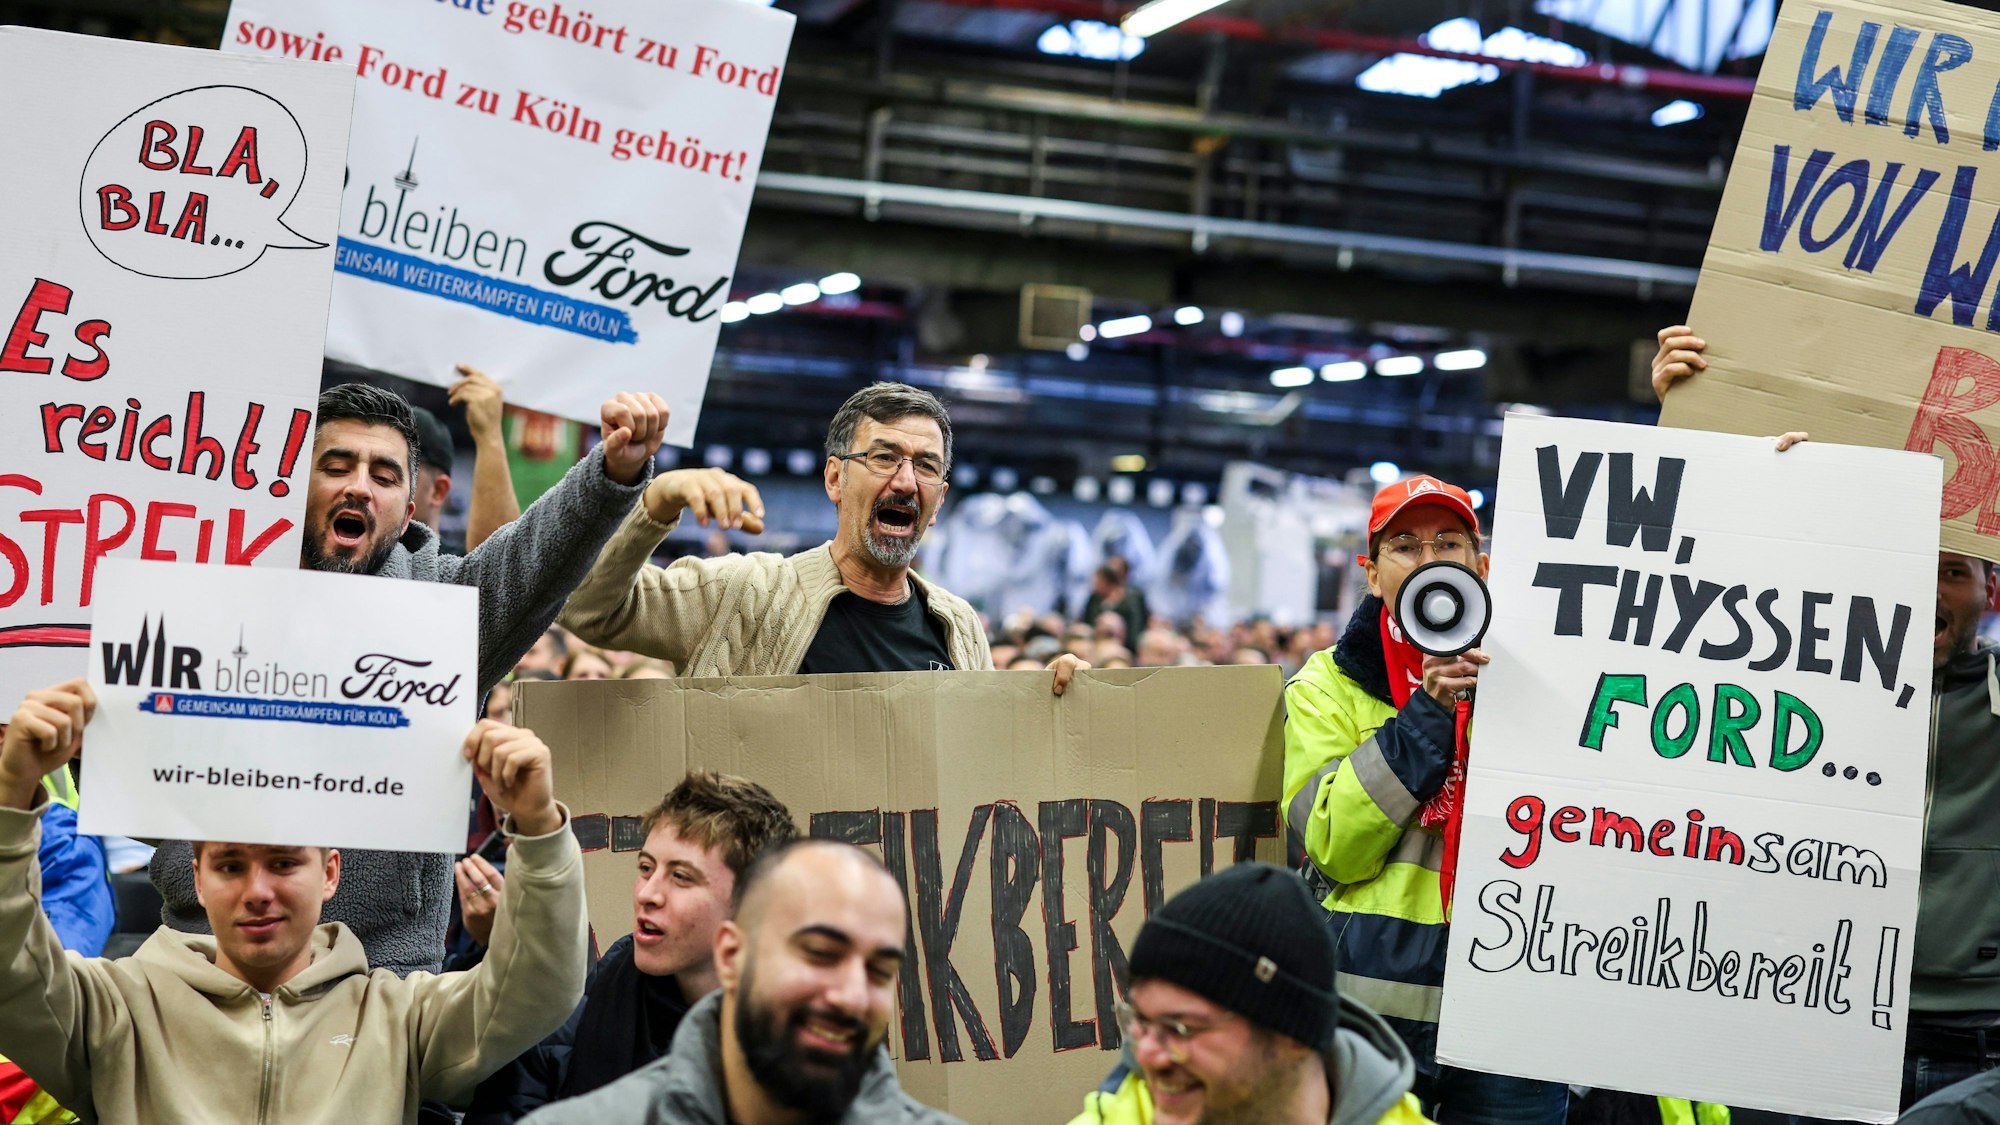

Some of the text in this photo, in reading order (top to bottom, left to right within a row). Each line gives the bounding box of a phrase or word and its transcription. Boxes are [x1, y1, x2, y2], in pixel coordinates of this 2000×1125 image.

[503, 1, 779, 96] gehört zu Ford
[1794, 10, 1973, 145] WIR
[236, 20, 747, 182] sowie Ford zu Köln gehört!
[139, 120, 279, 198] BLA,
[1759, 145, 1941, 273] VON
[98, 184, 244, 249] BLA...
[359, 184, 729, 323] bleiben Ford
[0, 278, 111, 381] Es
[336, 246, 621, 336] EINSAM WEITERKÄMPFEN FÜR KÖLN
[41, 391, 312, 497] reicht!
[1536, 445, 1695, 564] VW,
[102, 614, 461, 706] WIR bleiben Ford
[1532, 562, 1914, 708] THYSSEN,
[177, 699, 398, 725] GEMEINSAM WEITERKÄMPFEN FÜR KÖLN
[1578, 673, 1881, 786] FORD...
[153, 765, 404, 796] wir-bleiben-ford.de
[1499, 795, 1887, 888] gemeinsam
